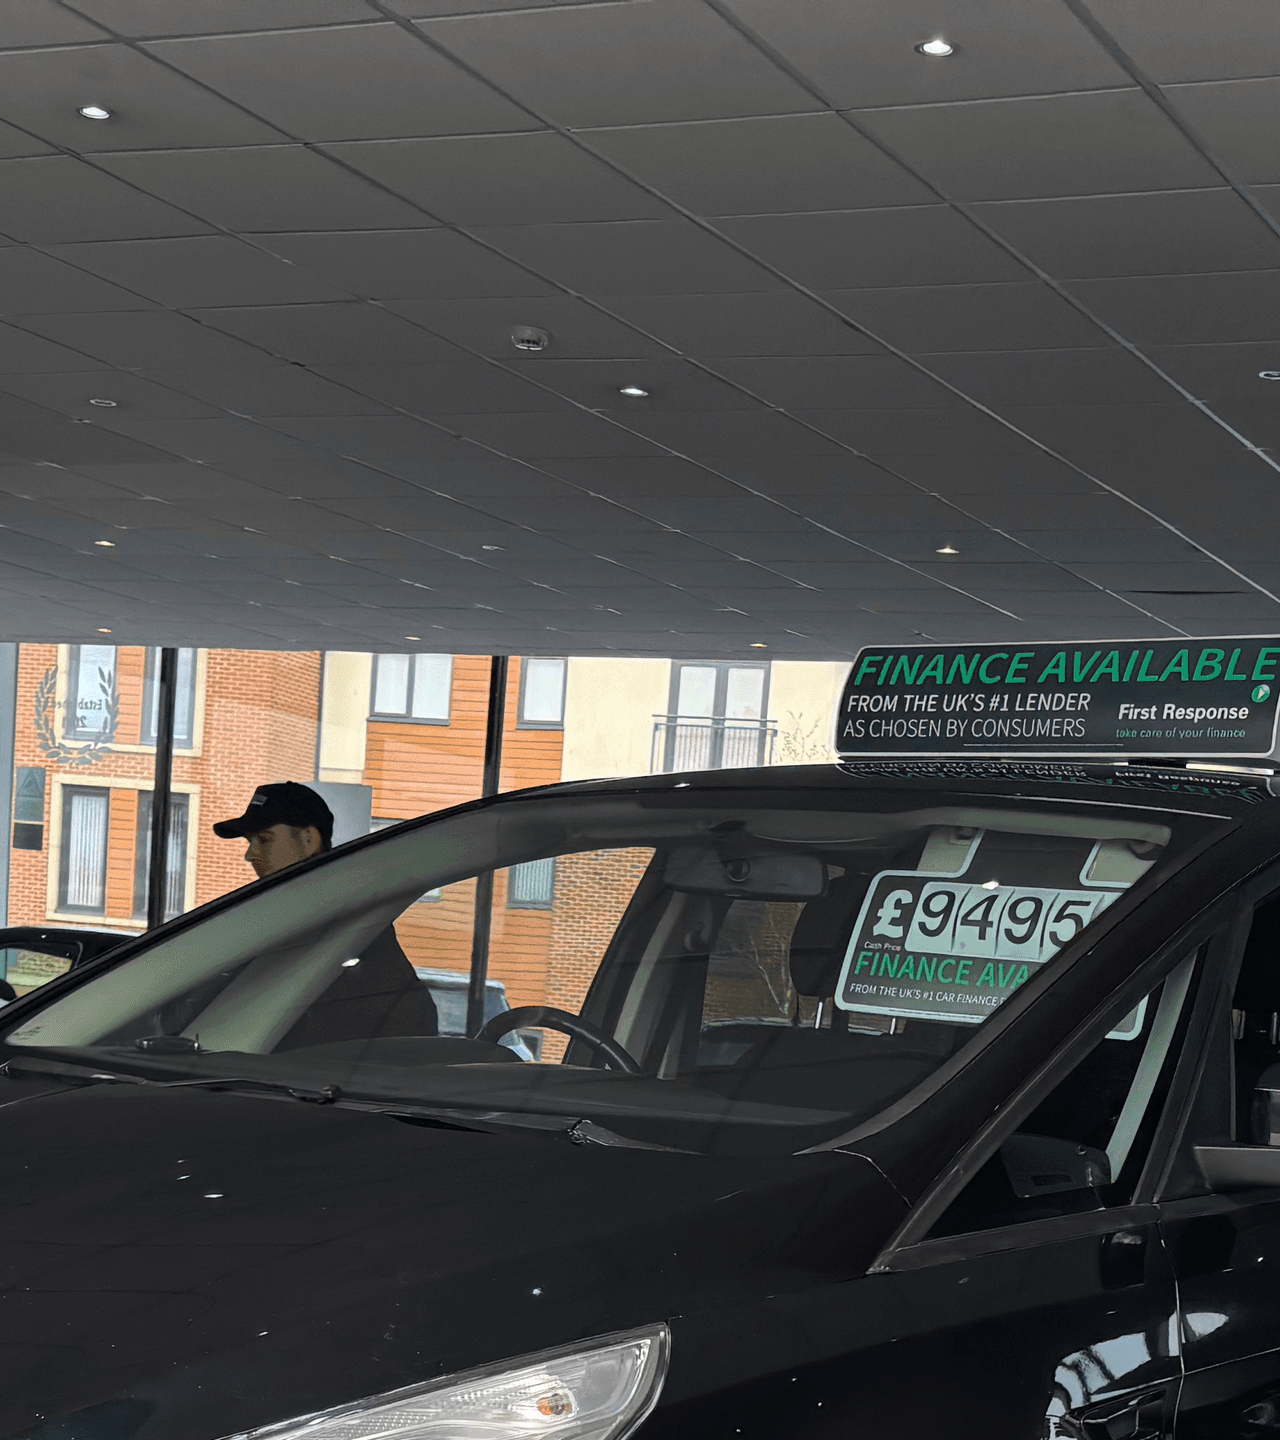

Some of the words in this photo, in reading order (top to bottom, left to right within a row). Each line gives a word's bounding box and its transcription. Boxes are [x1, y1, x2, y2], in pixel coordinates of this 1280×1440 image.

[854, 652, 1035, 685] FINANCE
[846, 694, 899, 713] FROM
[903, 694, 939, 712] THE
[989, 693, 1010, 711] #1
[1014, 692, 1092, 712] LENDER
[1118, 704, 1158, 720] First
[1162, 704, 1250, 723] Response
[843, 719, 866, 738] AS
[869, 718, 942, 738] CHOSEN
[945, 718, 969, 737] BY
[970, 718, 1087, 738] CONSUMERS
[1206, 726, 1246, 738] finance
[872, 889, 1091, 947] £9495
[854, 951, 974, 986] FINANCE
[975, 962, 1030, 990] AVA
[849, 983, 877, 994] FROM
[878, 986, 897, 996] THE
[922, 991, 934, 1000] #1
[935, 992, 955, 1002] CAR
[957, 994, 998, 1007] FINANCE
